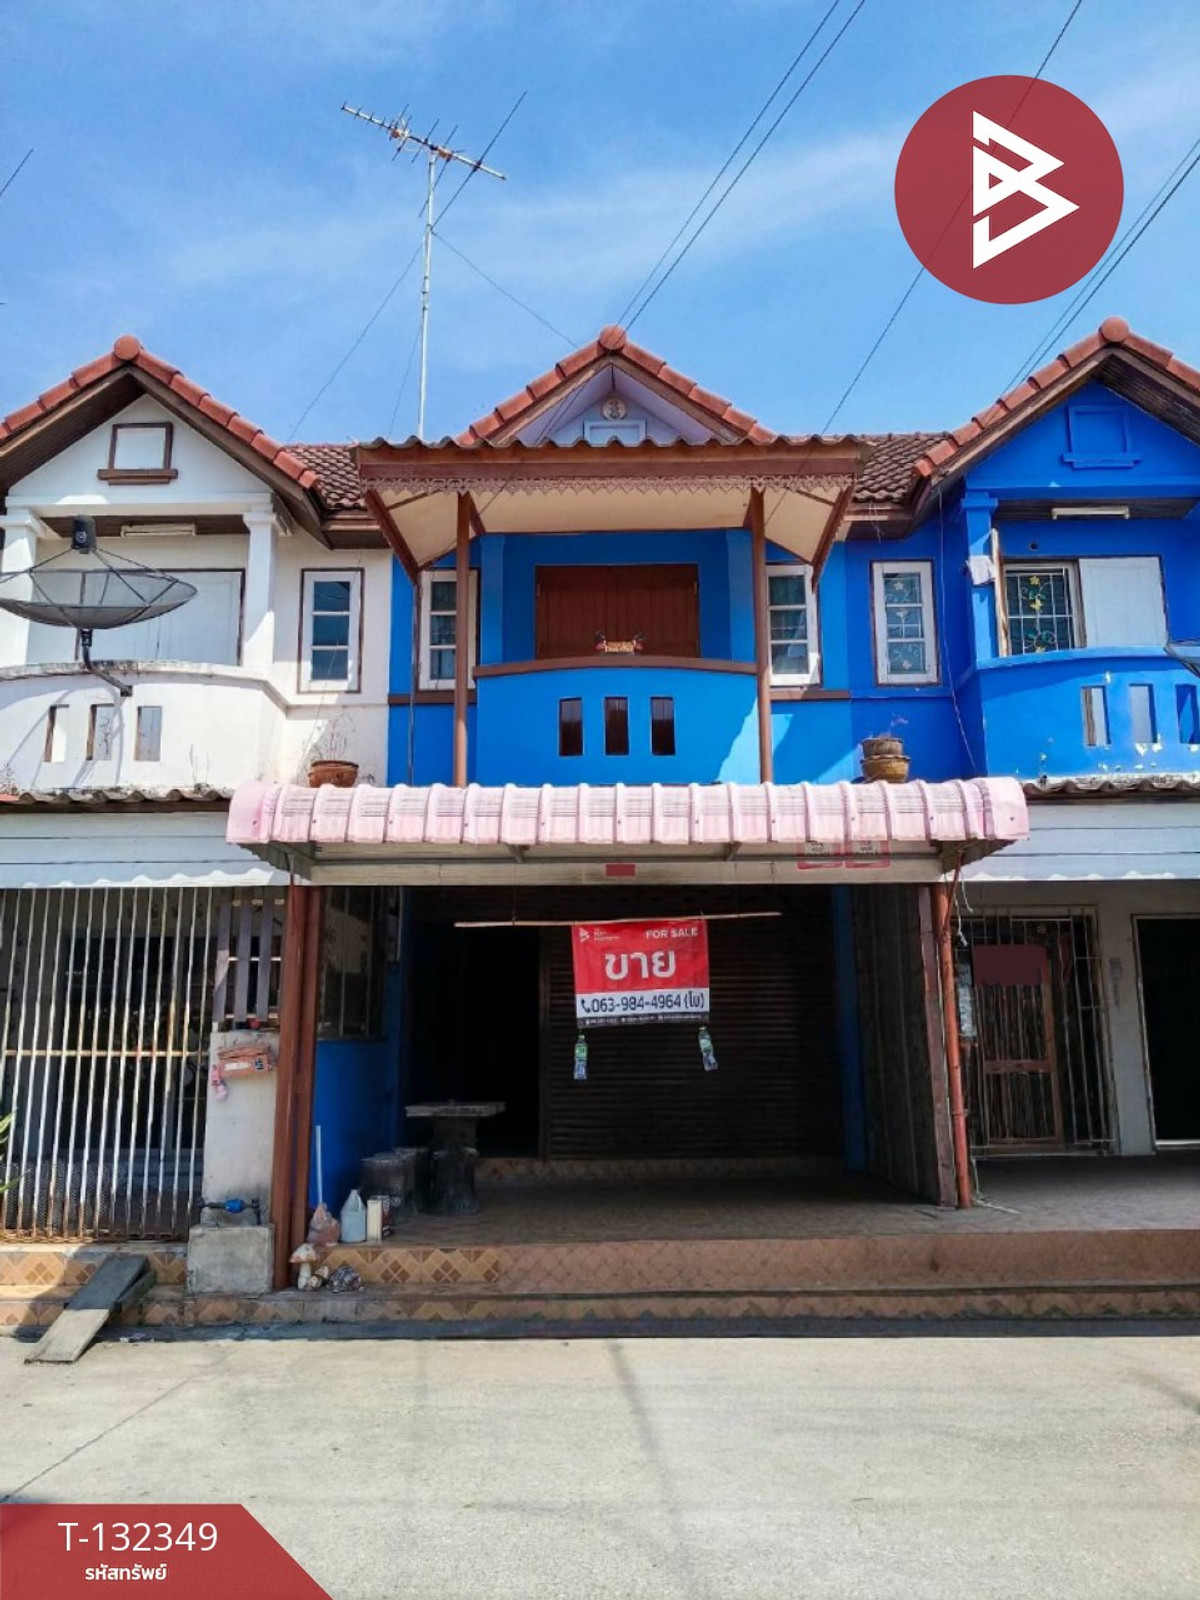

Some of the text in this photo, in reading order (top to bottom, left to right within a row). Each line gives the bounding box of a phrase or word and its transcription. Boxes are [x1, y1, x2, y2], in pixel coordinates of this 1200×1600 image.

[645, 927, 698, 939] FOR SALE
[604, 950, 677, 980] ขาย
[592, 994, 681, 1013] 063-984-4964
